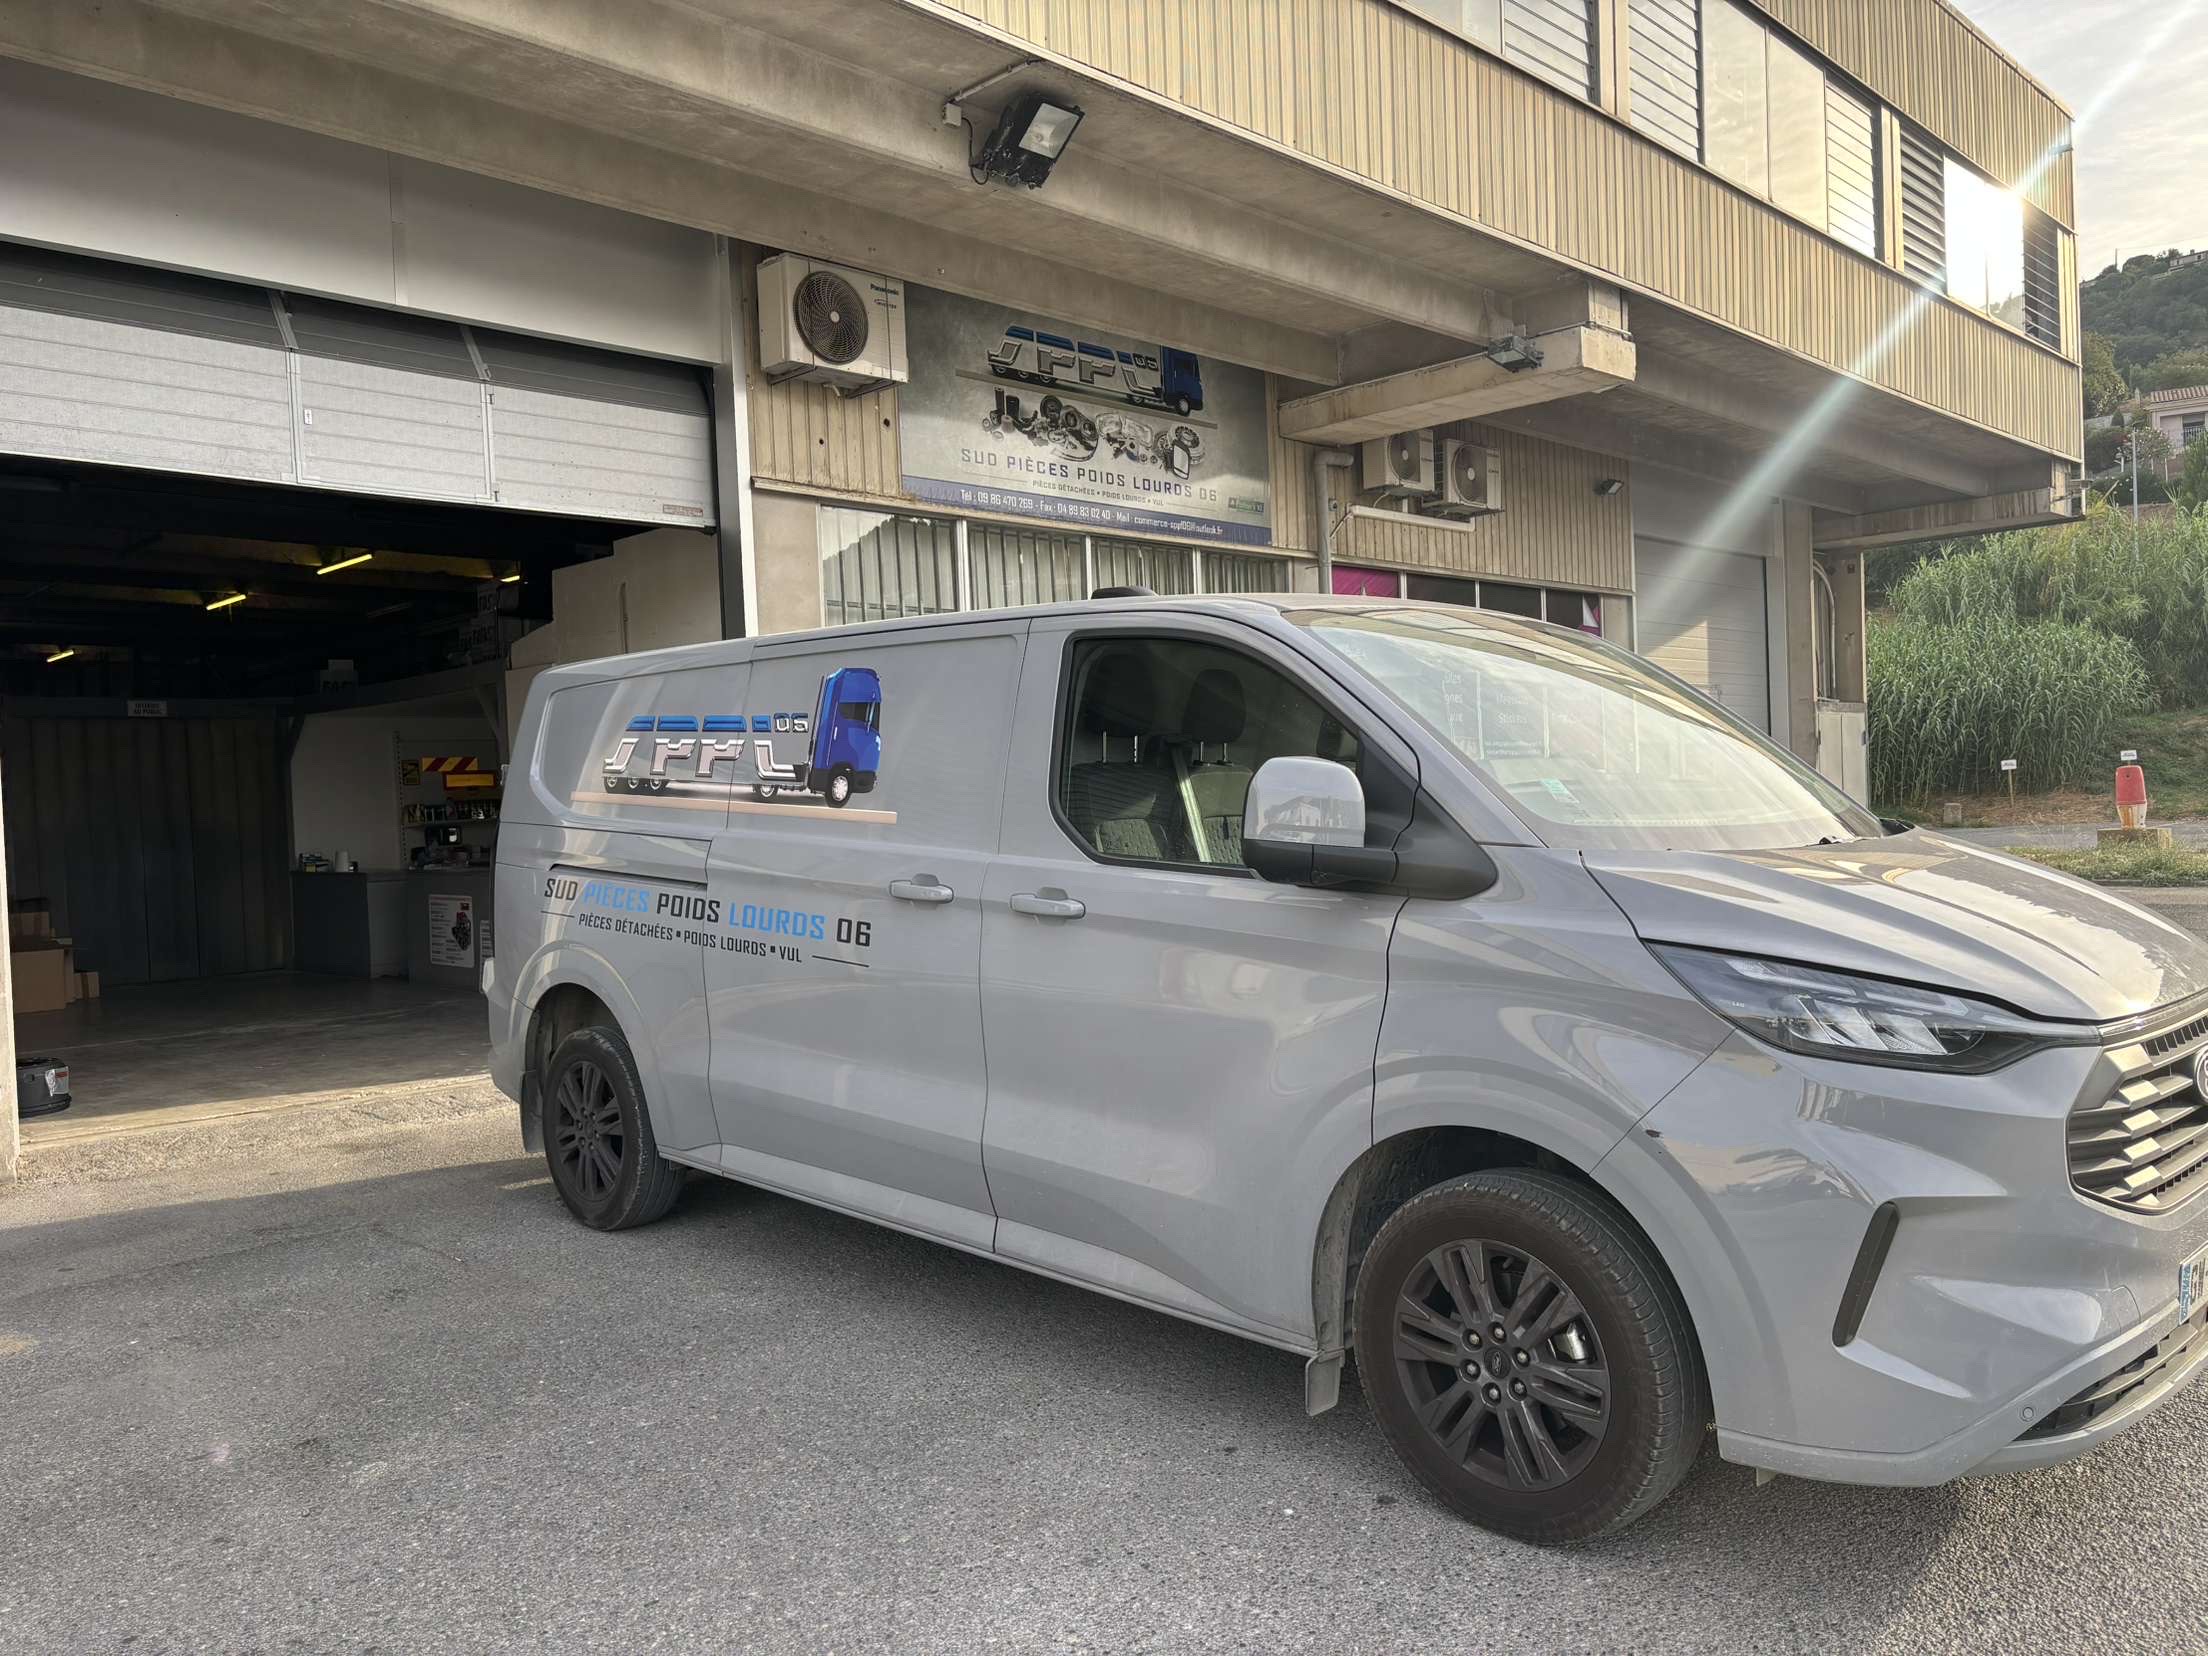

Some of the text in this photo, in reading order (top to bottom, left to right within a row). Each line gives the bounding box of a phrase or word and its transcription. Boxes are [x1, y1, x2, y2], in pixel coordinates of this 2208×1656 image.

[961, 449, 1217, 501] SUD PIÈCES POIDS LOURDS 06
[1102, 490, 1120, 499] POIDS
[978, 491, 989, 504] 09
[990, 494, 1001, 505] 86
[1002, 496, 1017, 507] 470
[1018, 497, 1033, 509] 269
[1057, 503, 1067, 514] 04
[1069, 504, 1079, 515] 89
[1080, 506, 1090, 517] 83
[1091, 507, 1100, 518] 02
[1101, 509, 1111, 520] 40
[544, 878, 872, 947] SUD PIÈCES POIDS LOURDS 06
[615, 919, 673, 941] DÉTACHÉES
[683, 930, 717, 948] POIDS
[720, 936, 767, 957] LOURDS
[779, 945, 803, 963] VUL
